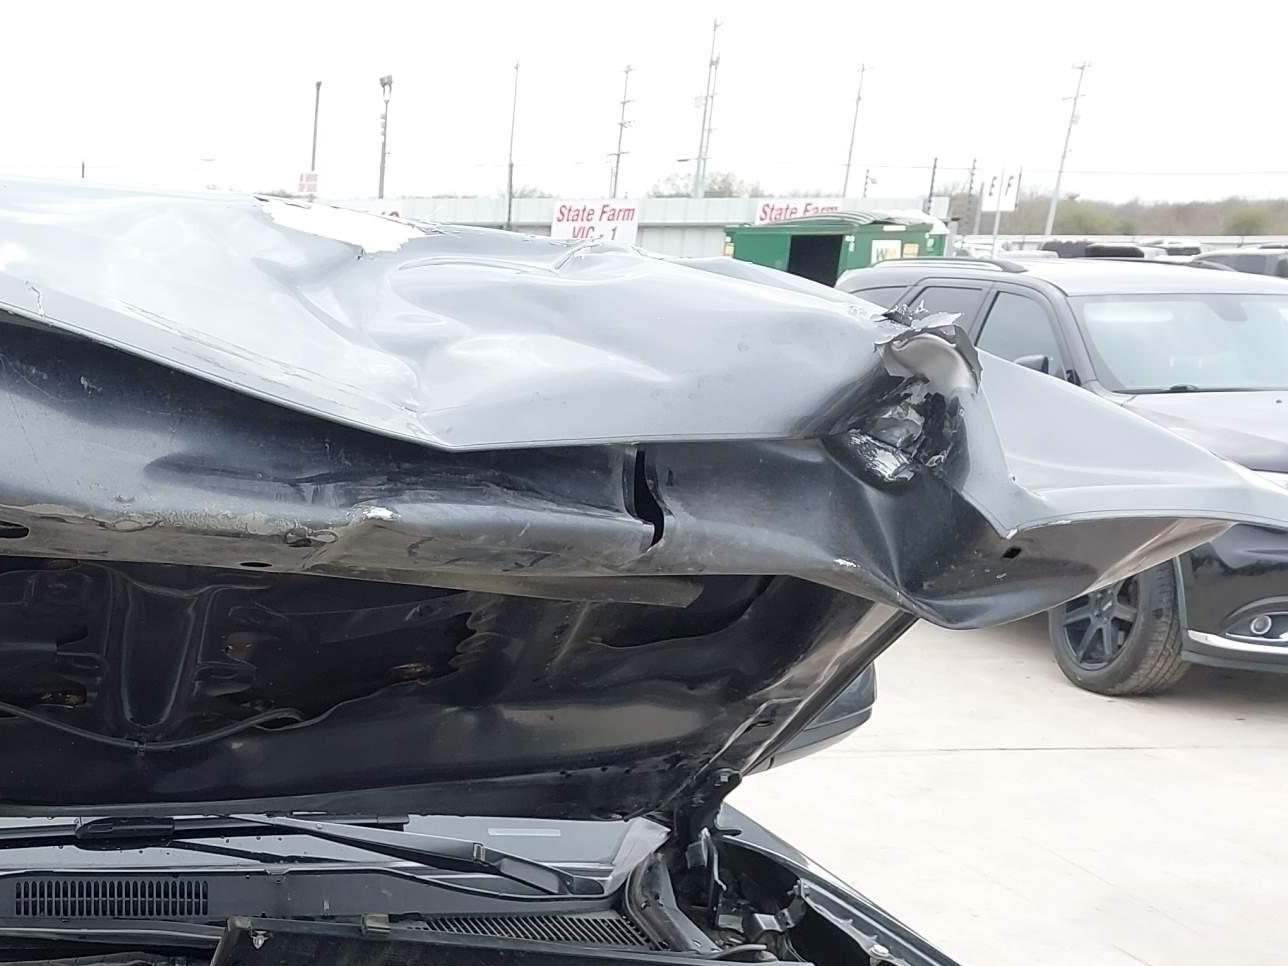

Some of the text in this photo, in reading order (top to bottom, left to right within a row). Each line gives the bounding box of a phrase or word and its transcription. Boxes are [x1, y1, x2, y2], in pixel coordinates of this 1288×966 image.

[556, 204, 636, 222] State Farm
[759, 203, 798, 222] State
[572, 225, 595, 239] VIC
